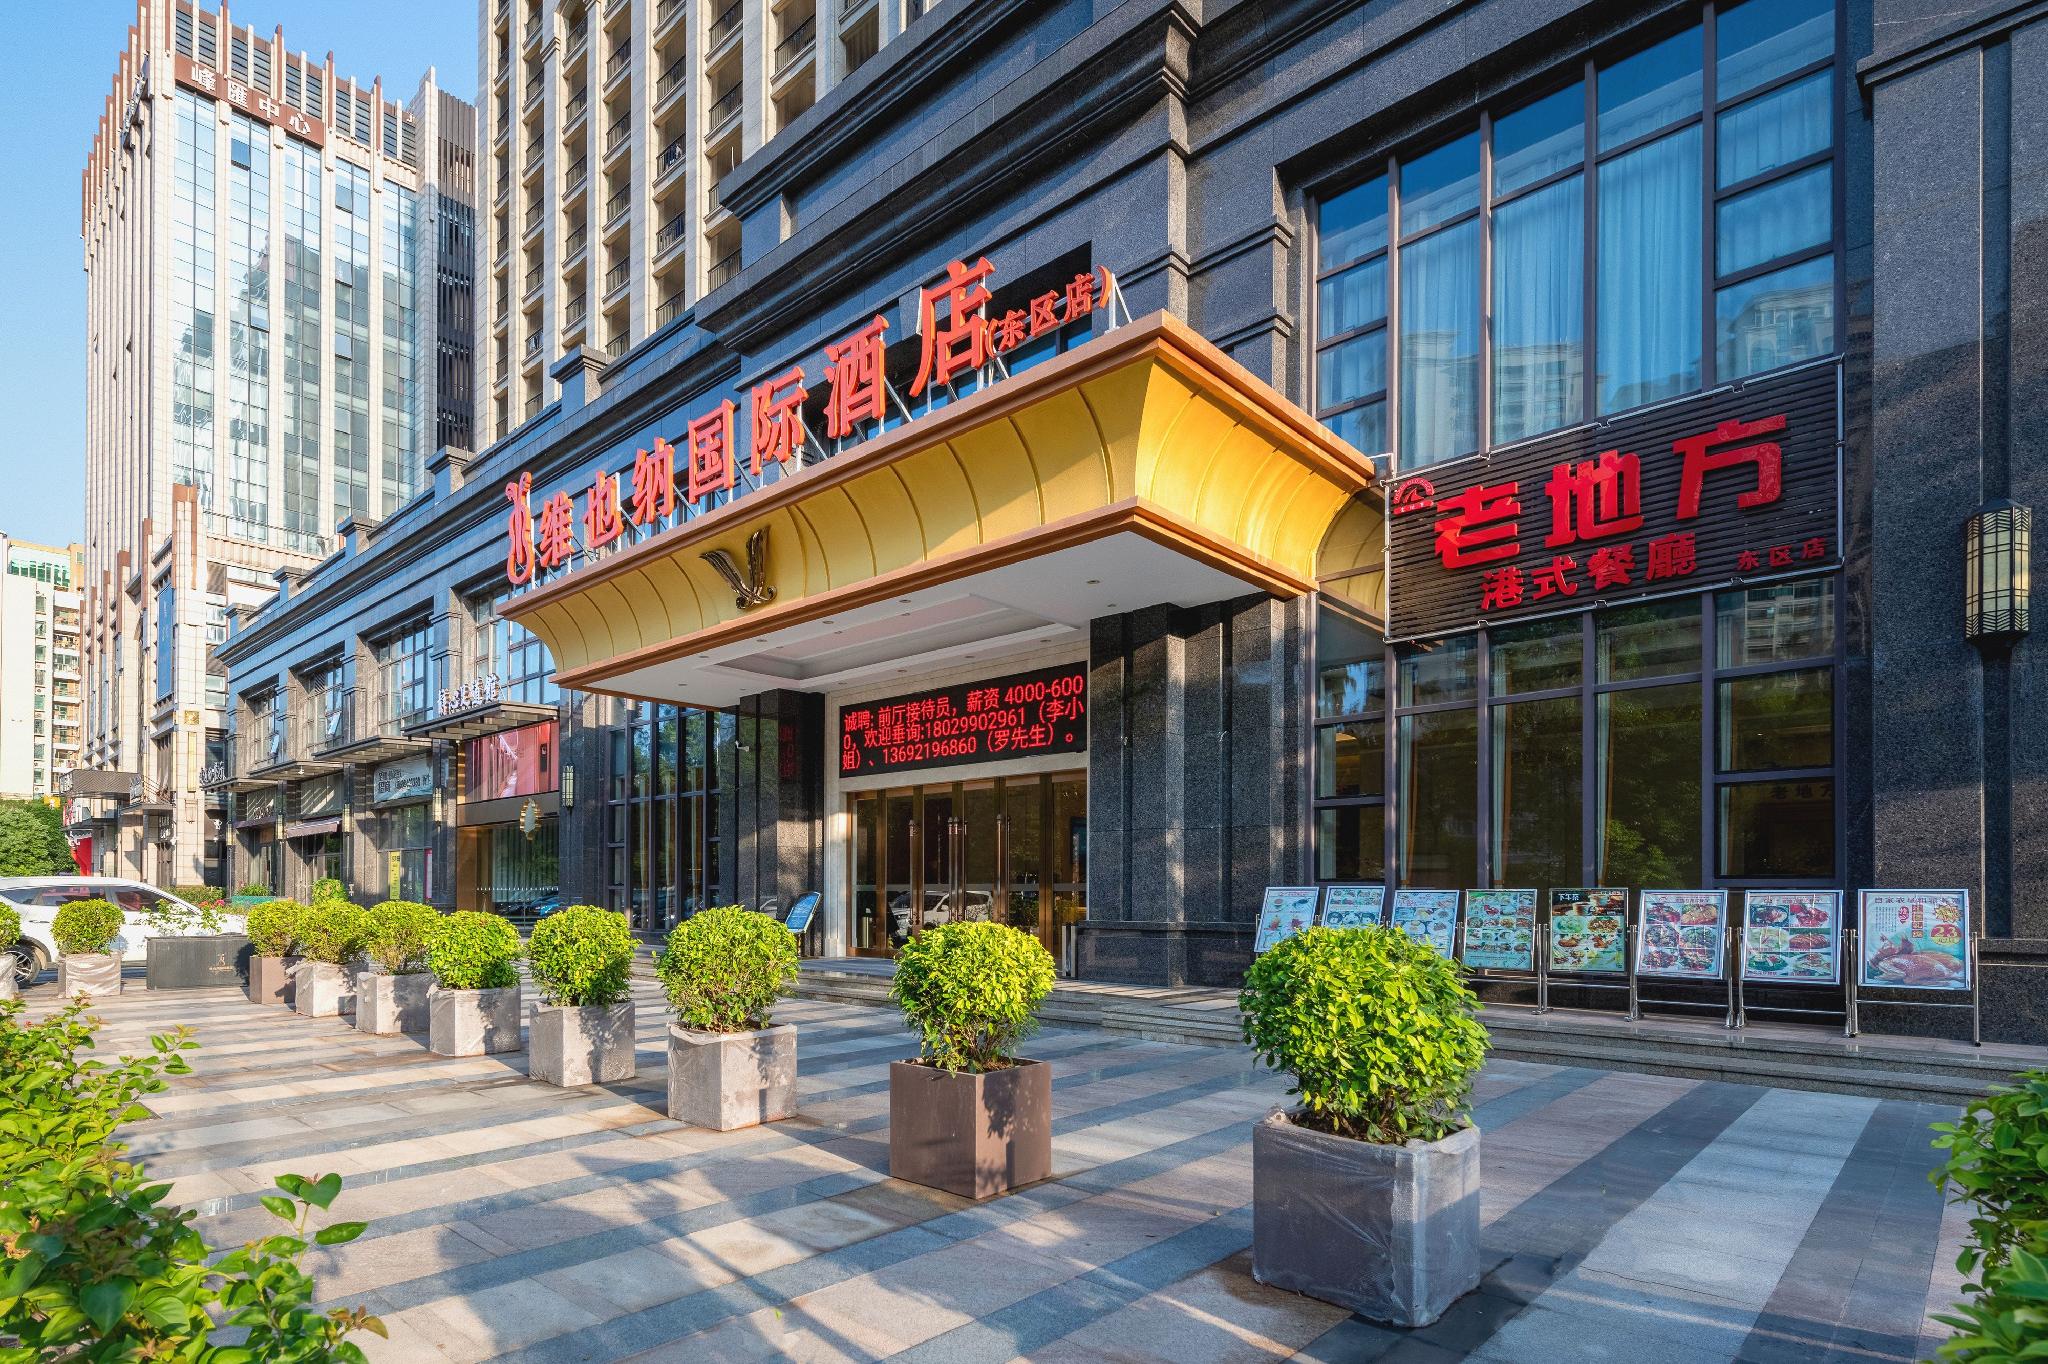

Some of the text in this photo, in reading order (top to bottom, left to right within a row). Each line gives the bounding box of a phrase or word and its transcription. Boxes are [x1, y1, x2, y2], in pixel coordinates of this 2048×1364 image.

[191, 63, 311, 135] 峰匯中心
[540, 257, 996, 568] 维也纳国际酒店
[1434, 414, 1786, 569] 老地方
[1480, 532, 1697, 611] 港式餐廳
[1737, 537, 1826, 572] 东区店
[1004, 674, 1084, 704] 4000-600
